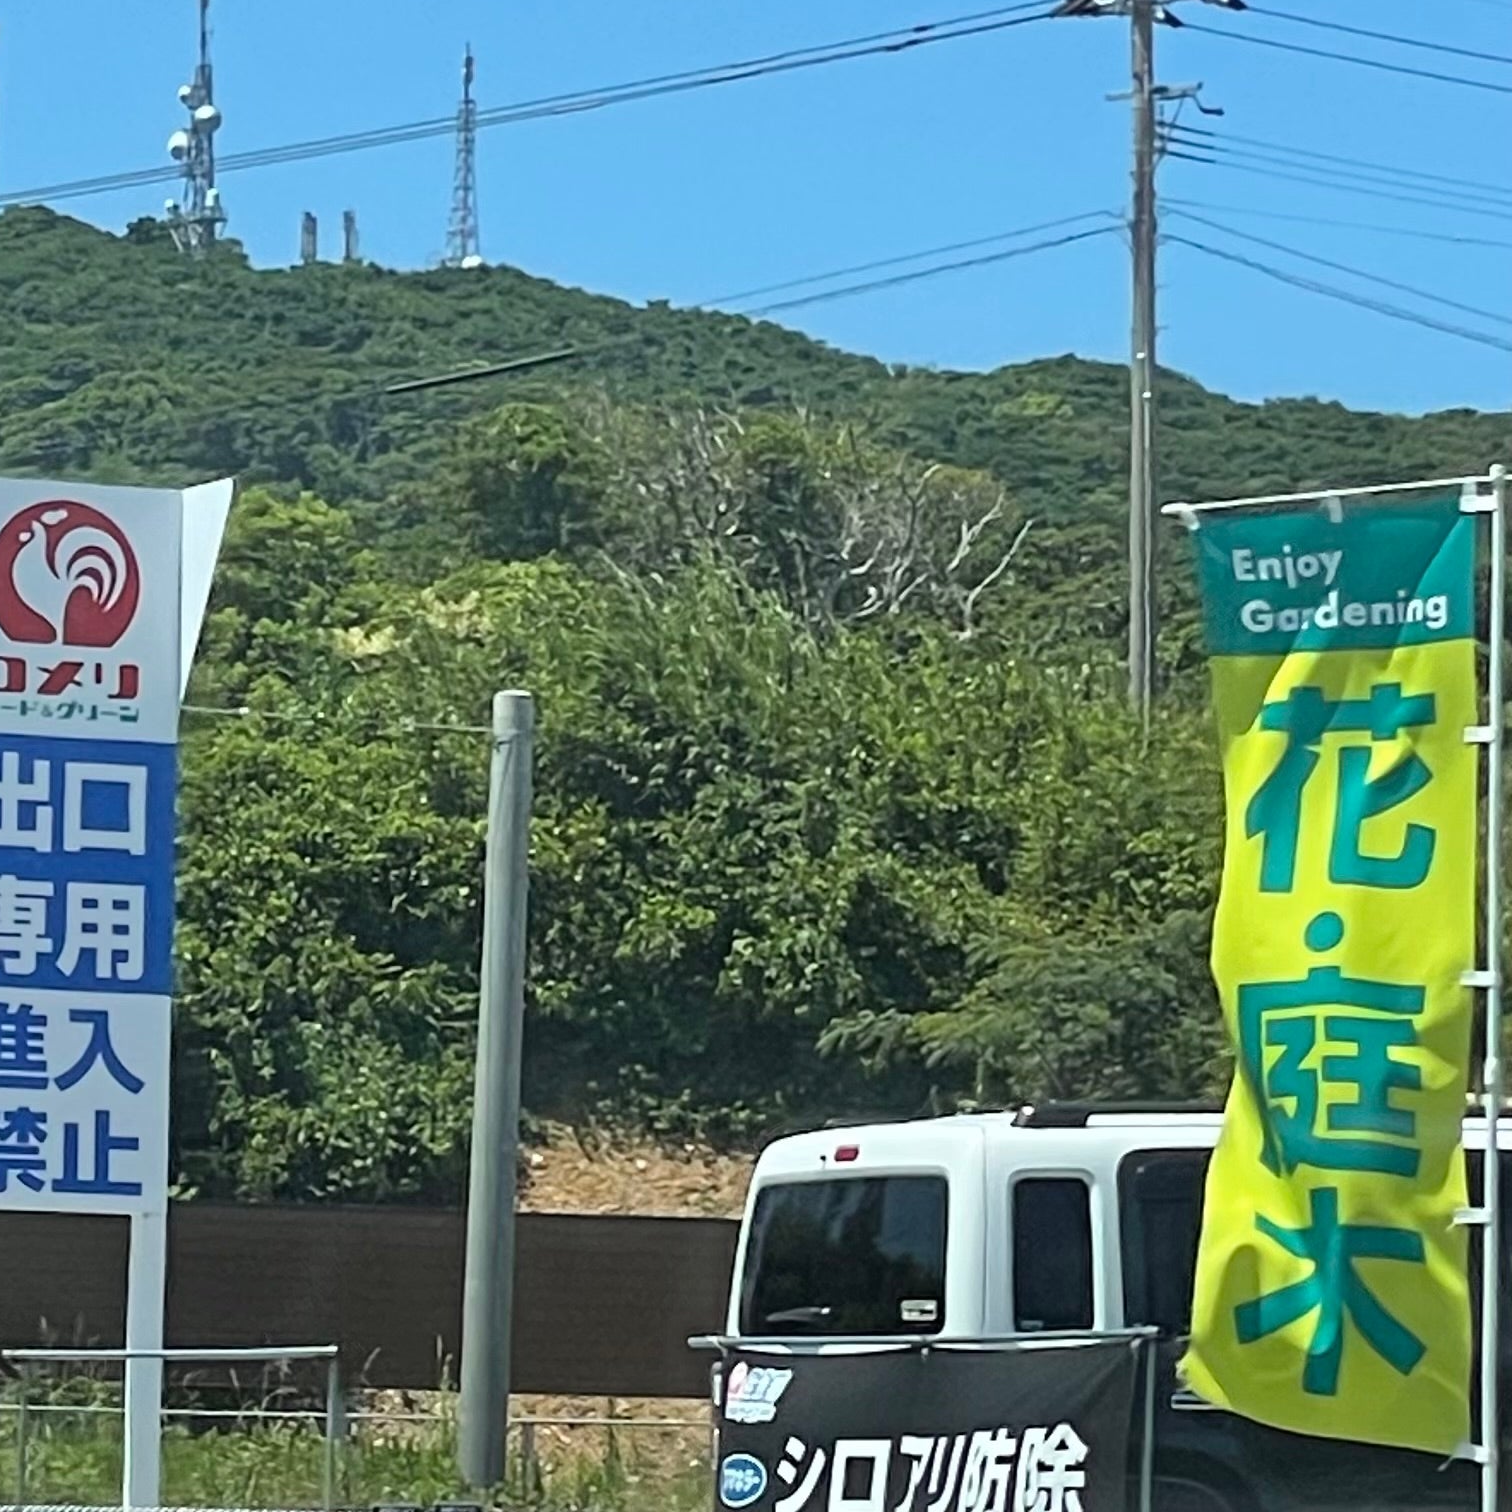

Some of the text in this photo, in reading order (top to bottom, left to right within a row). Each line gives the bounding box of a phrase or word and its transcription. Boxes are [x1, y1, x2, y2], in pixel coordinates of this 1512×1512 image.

[1231, 545, 1344, 589] Enjoy
[1240, 588, 1449, 633] Gardening
[774, 1422, 1089, 1512] シロアリ防除
